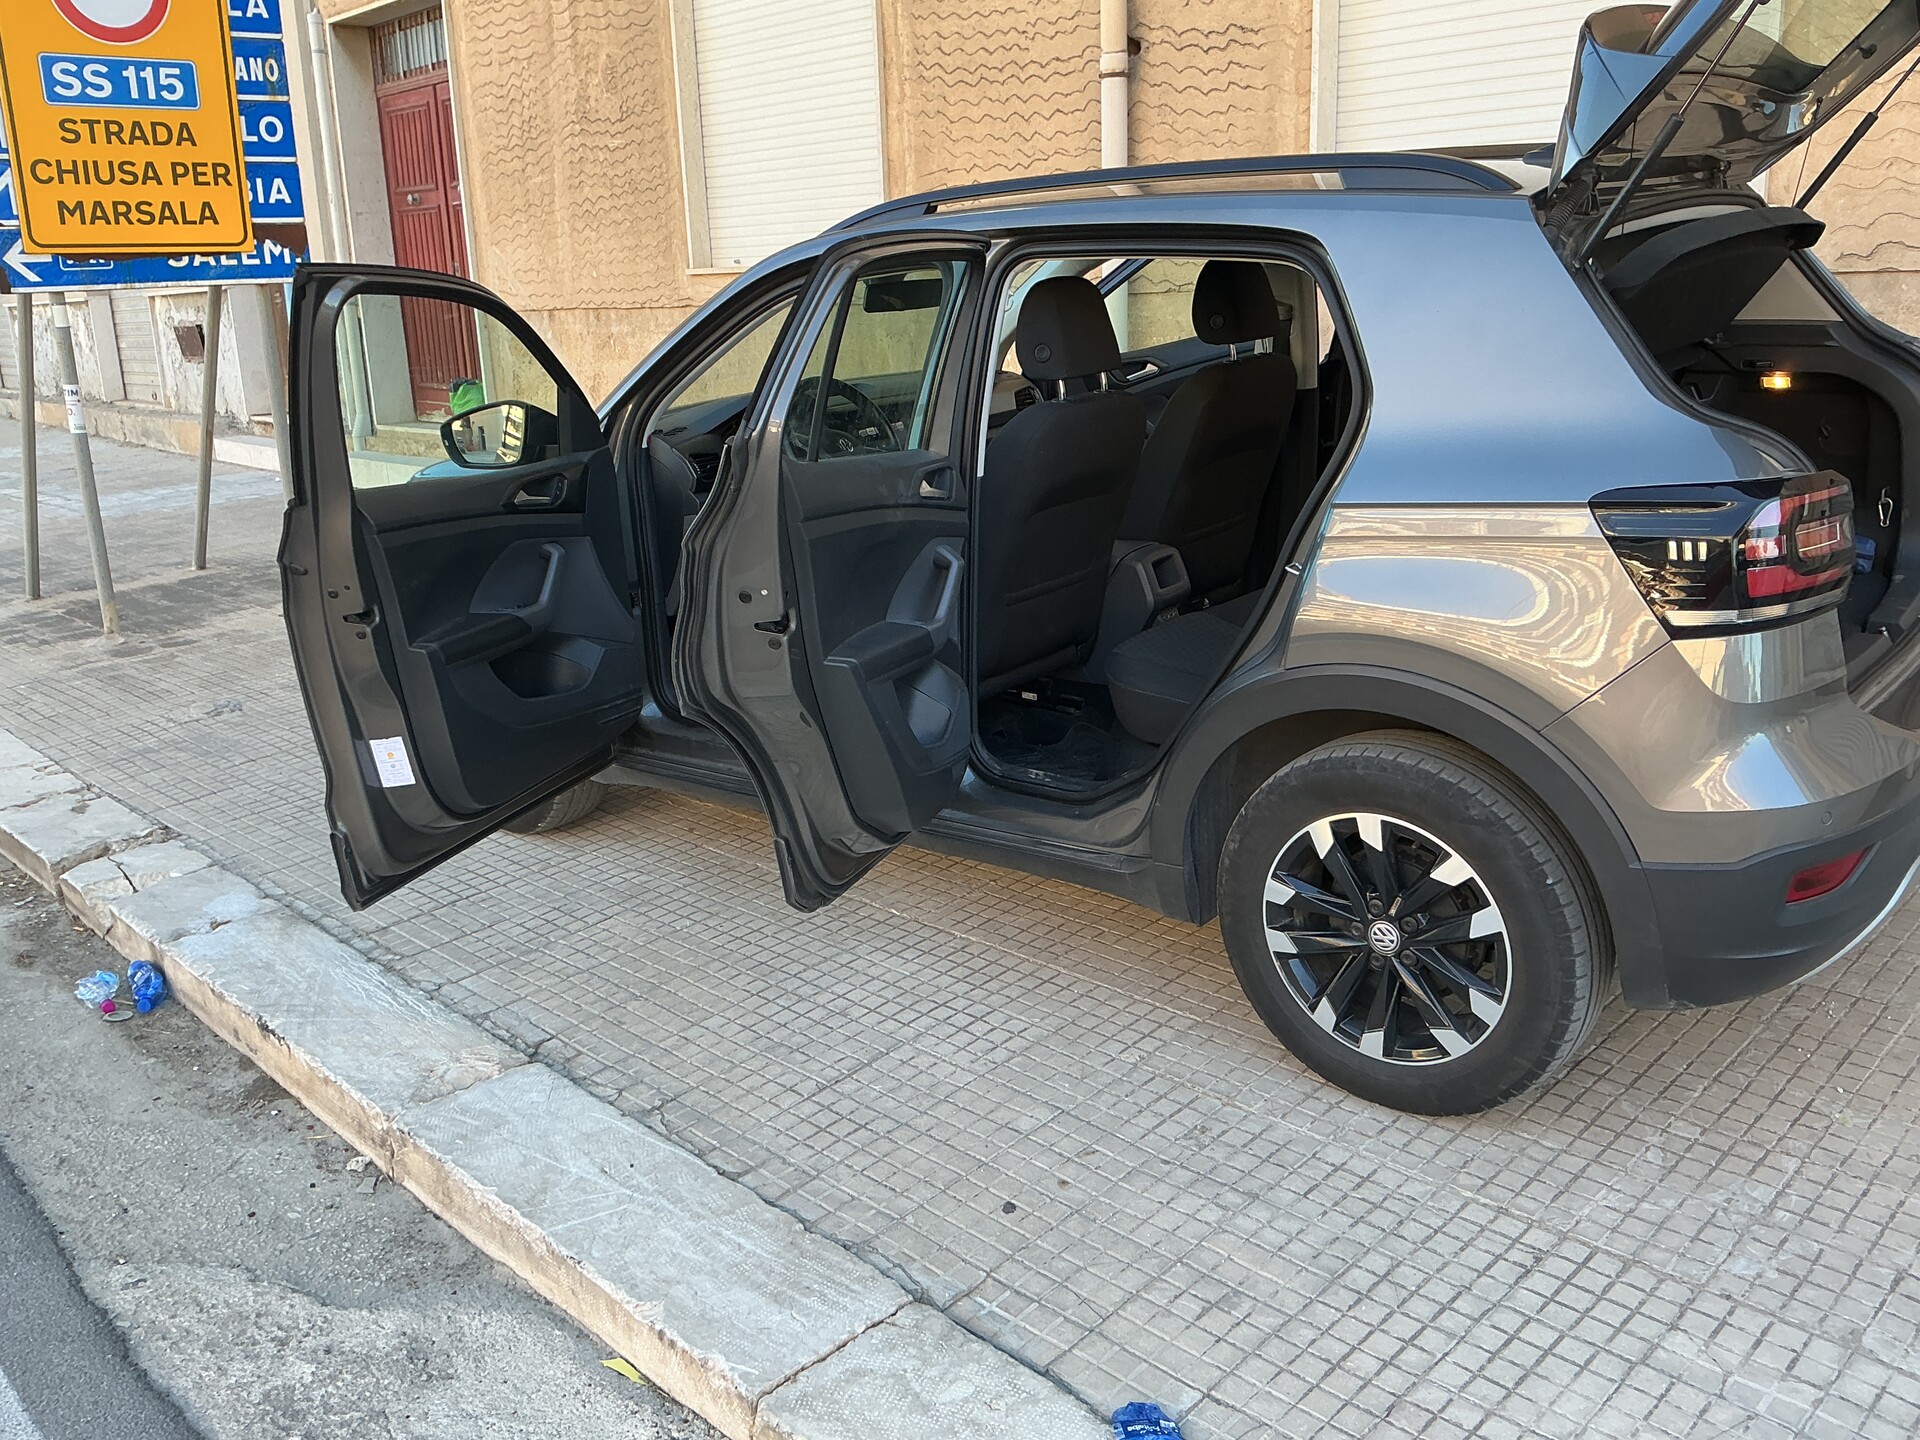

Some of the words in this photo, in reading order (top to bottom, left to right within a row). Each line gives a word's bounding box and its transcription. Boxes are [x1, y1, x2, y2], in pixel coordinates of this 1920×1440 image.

[51, 61, 113, 98] SS
[122, 65, 184, 101] 115
[58, 117, 198, 147] STRADA
[30, 158, 163, 186] CHIUSA
[170, 161, 233, 187] PER
[57, 200, 220, 225] MARSALA
